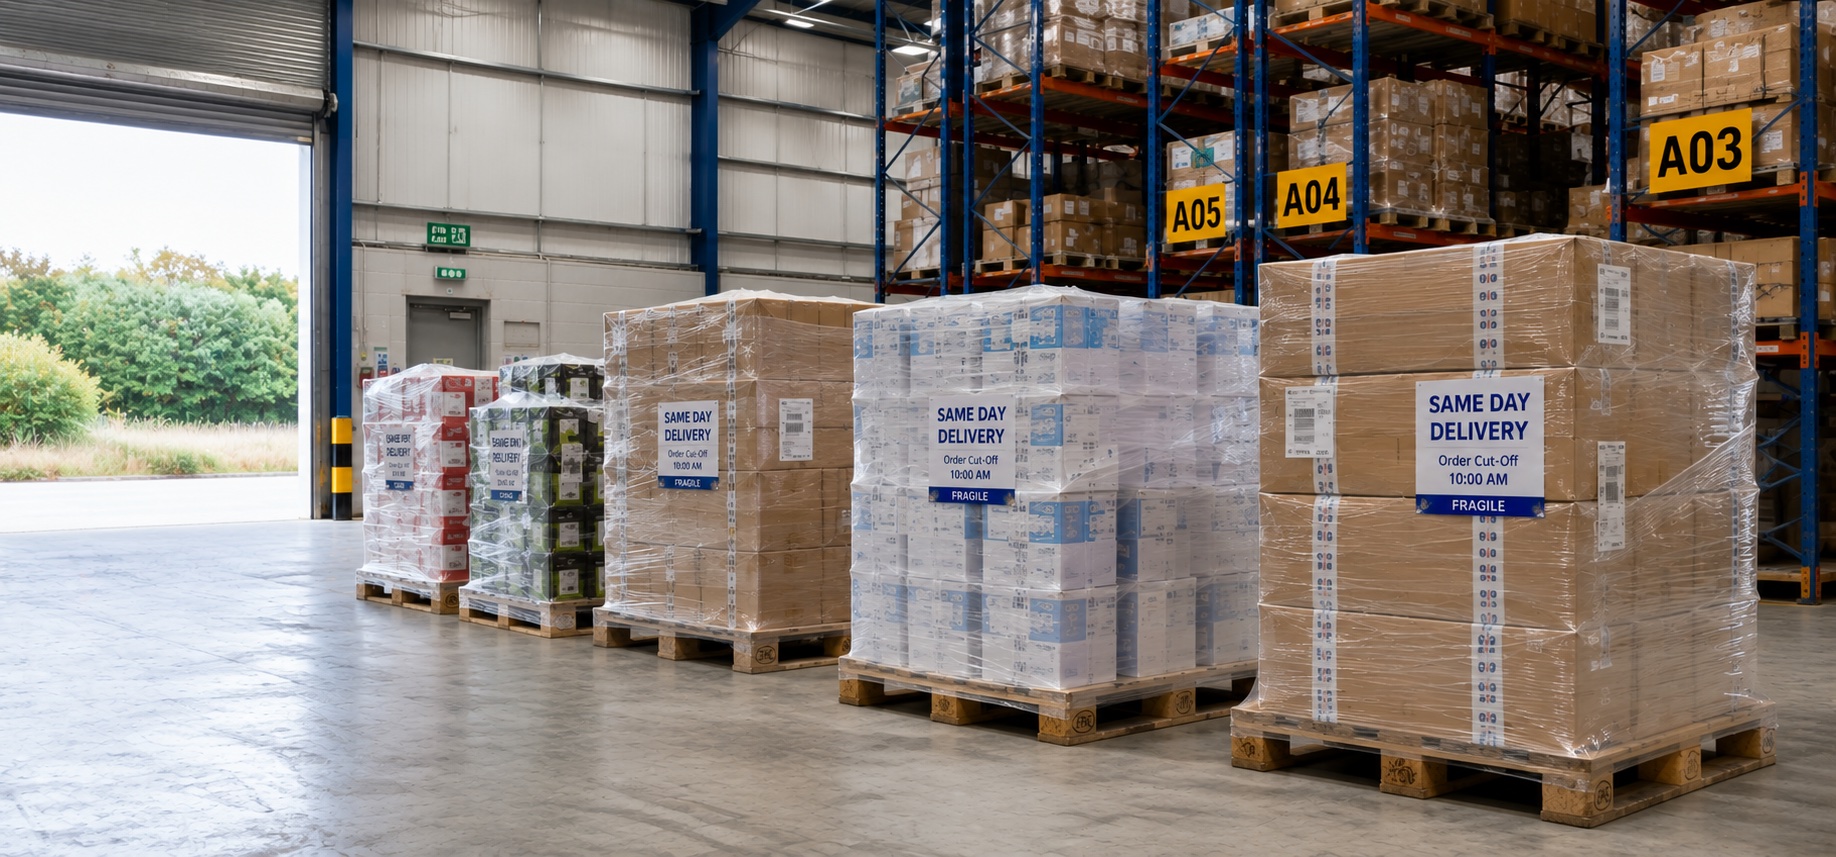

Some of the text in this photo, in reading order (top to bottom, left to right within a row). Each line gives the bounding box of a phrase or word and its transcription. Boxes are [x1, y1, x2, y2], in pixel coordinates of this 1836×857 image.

[1657, 126, 1742, 178] A03
[1283, 176, 1340, 217] A04
[1172, 196, 1221, 233] A05
[1429, 392, 1531, 414] SAME DAY
[664, 410, 713, 424] SAME DAY
[937, 406, 1007, 422] SAME DAY
[664, 428, 712, 442] DELIVERY
[938, 428, 1005, 444] DELIVERY
[1430, 420, 1529, 441] DELIVERY
[691, 462, 703, 470] AM
[943, 454, 999, 465] Order Cut-Off
[1438, 454, 1519, 467] Order Cut-Off
[950, 469, 991, 480] 10:00 AM
[1449, 472, 1508, 486] 10:00 AM
[951, 490, 989, 501] FRAGILE
[1452, 499, 1505, 513] FRAGILE
